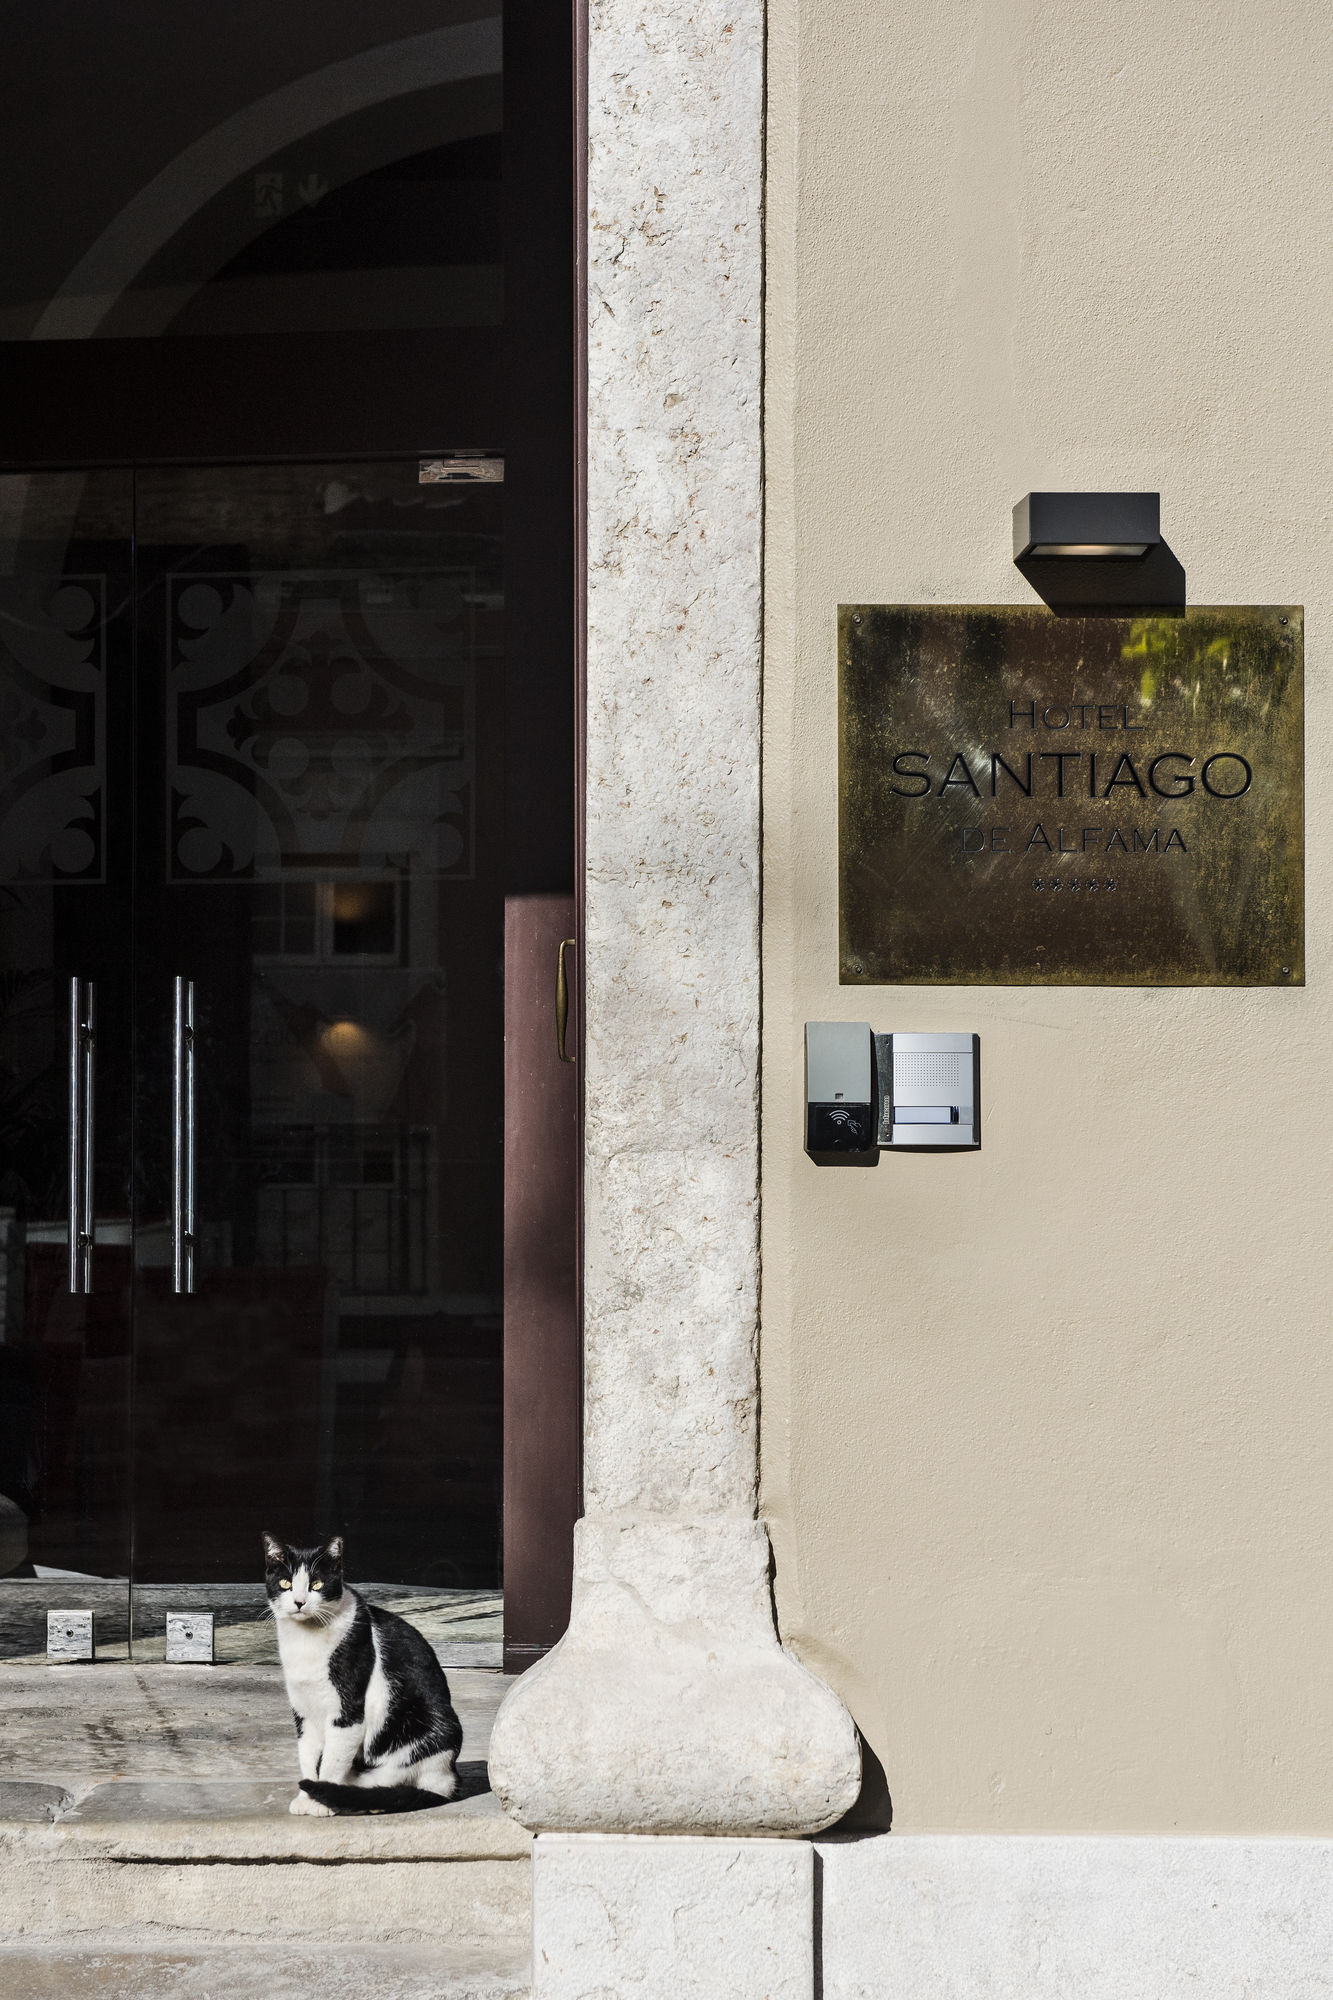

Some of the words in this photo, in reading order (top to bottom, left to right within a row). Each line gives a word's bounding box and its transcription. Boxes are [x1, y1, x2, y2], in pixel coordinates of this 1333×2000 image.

[1009, 700, 1145, 731] HOTEL
[889, 752, 1253, 799] SANTIAGO
[961, 827, 1012, 854] DE
[1027, 822, 1187, 854] ALFAMA
